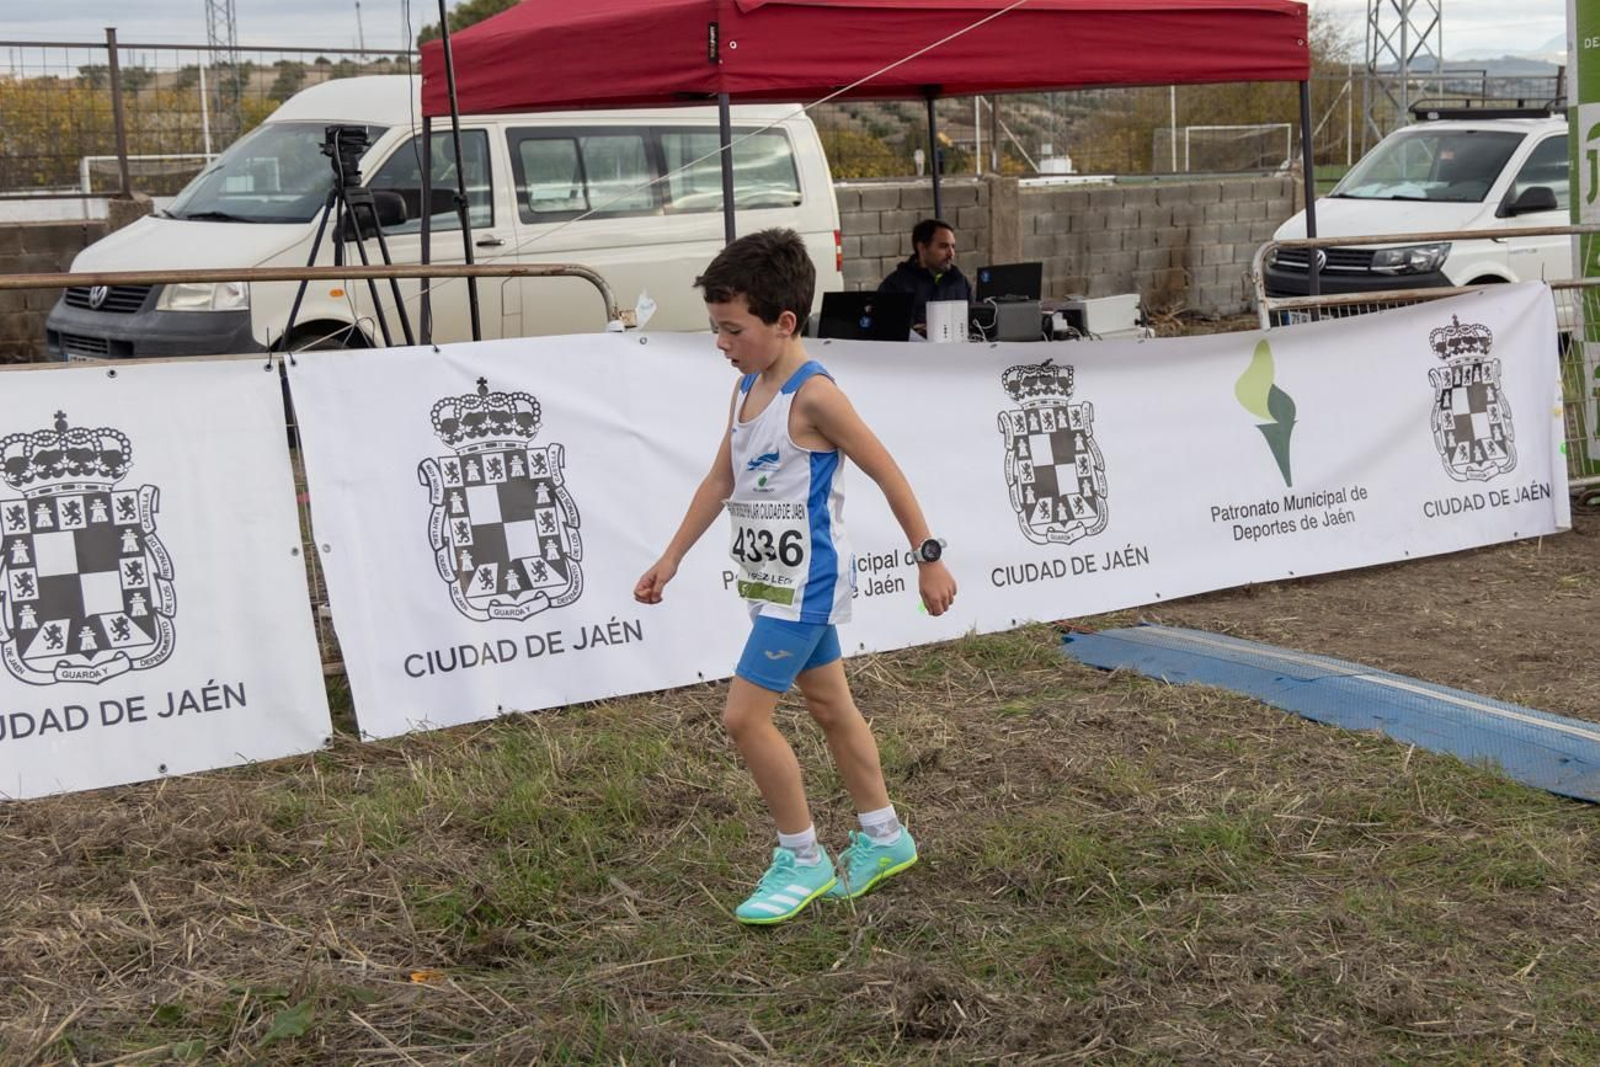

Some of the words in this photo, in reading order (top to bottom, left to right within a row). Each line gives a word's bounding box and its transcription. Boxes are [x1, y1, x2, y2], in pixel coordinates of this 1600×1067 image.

[143, 493, 151, 529] CASTILLA
[1210, 499, 1280, 523] Patronato
[1283, 488, 1347, 515] Municipal
[1350, 485, 1368, 503] de
[1423, 493, 1485, 518] CIUDAD
[1488, 489, 1510, 507] DE
[1514, 480, 1551, 504] JAÉN
[147, 536, 158, 548] DE
[1232, 516, 1297, 543] Deportes
[1299, 513, 1319, 532] de
[1321, 507, 1356, 529] Jaén
[733, 525, 804, 567] 4336
[857, 549, 898, 575] cipal
[991, 559, 1067, 587] CIUDAD
[1072, 554, 1097, 575] DE
[1102, 544, 1150, 572] JAÉN
[163, 586, 172, 603] LOS
[864, 573, 905, 597] Jaén
[5, 647, 14, 658] DE
[404, 639, 517, 678] CIUDAD
[525, 630, 565, 658] DE
[573, 617, 643, 651] JAÉN
[62, 669, 101, 679] GUARDA
[102, 666, 109, 675] Y
[100, 694, 148, 727] DE
[157, 679, 247, 718] JAÉN
